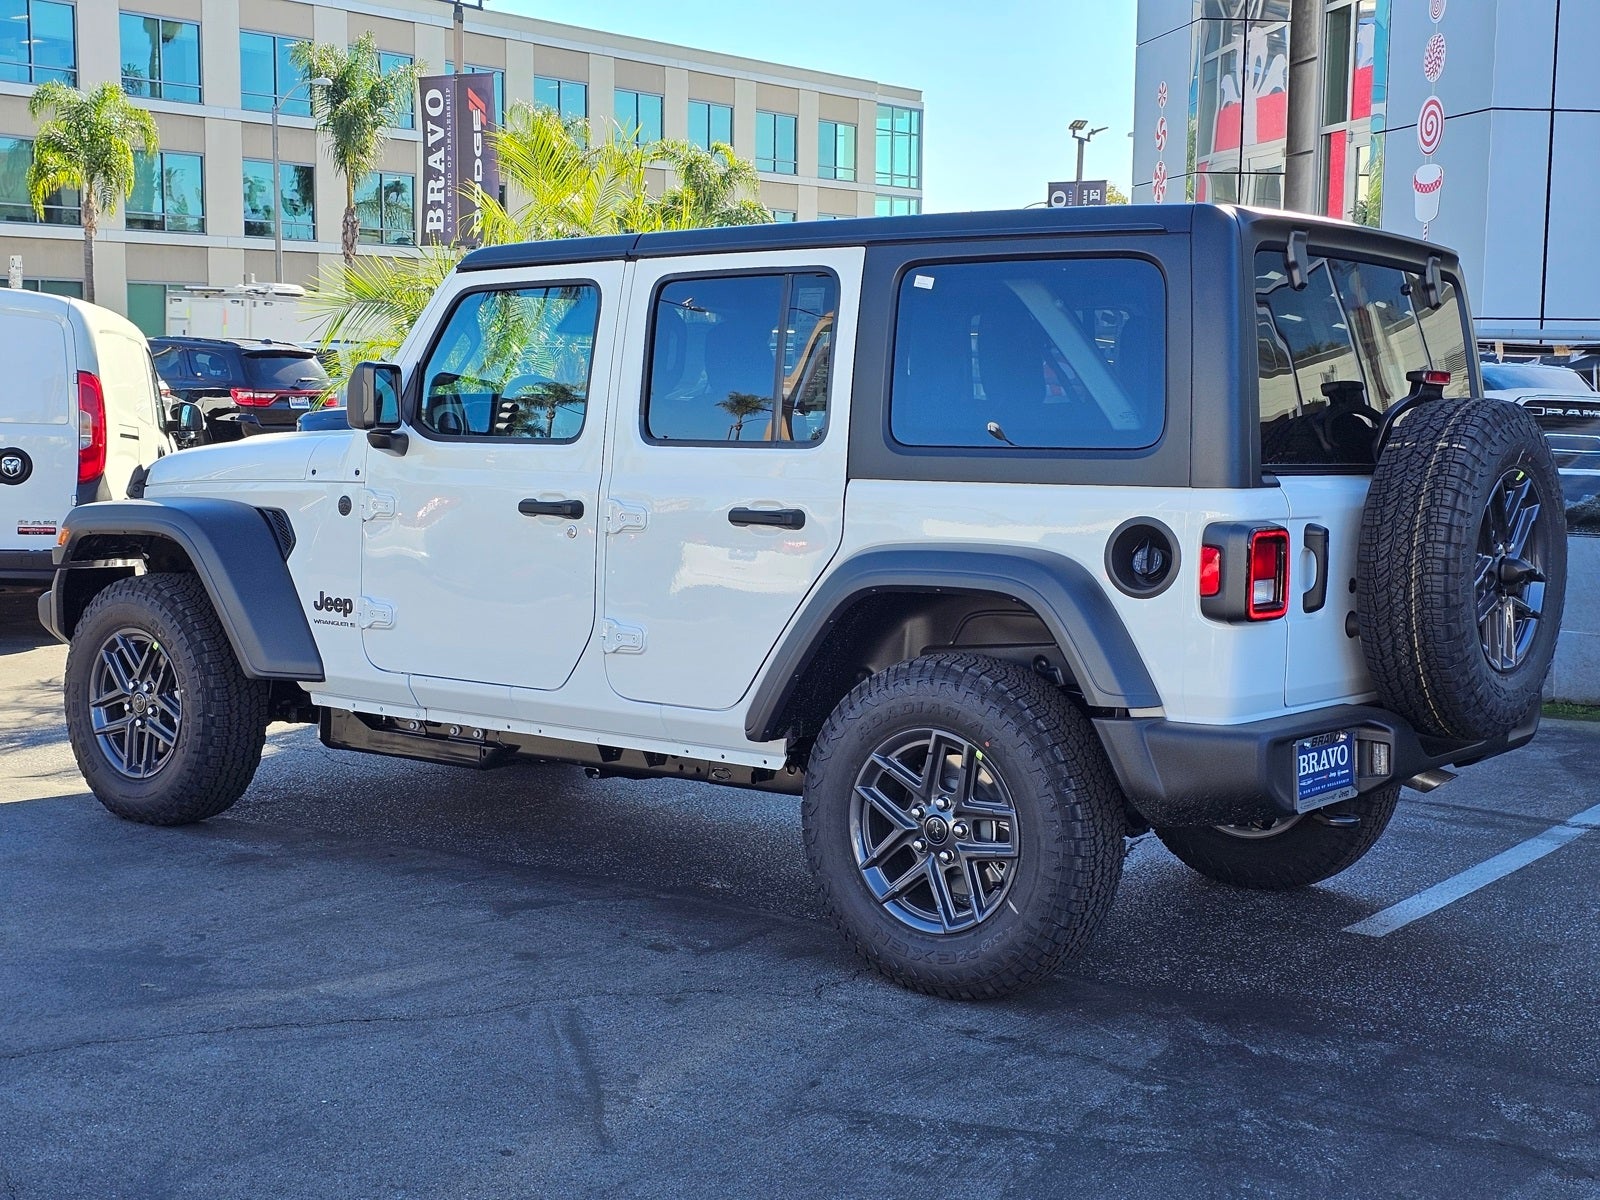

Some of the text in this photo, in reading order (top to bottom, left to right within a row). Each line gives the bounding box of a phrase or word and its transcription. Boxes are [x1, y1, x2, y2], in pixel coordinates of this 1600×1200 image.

[425, 88, 445, 234] BRAVO
[447, 155, 452, 168] OF
[1546, 408, 1600, 417] RAM
[313, 590, 354, 618] Jeep
[313, 619, 349, 627] WRANGLER
[1311, 731, 1342, 748] BRAVO
[1298, 744, 1349, 777] BRAVO
